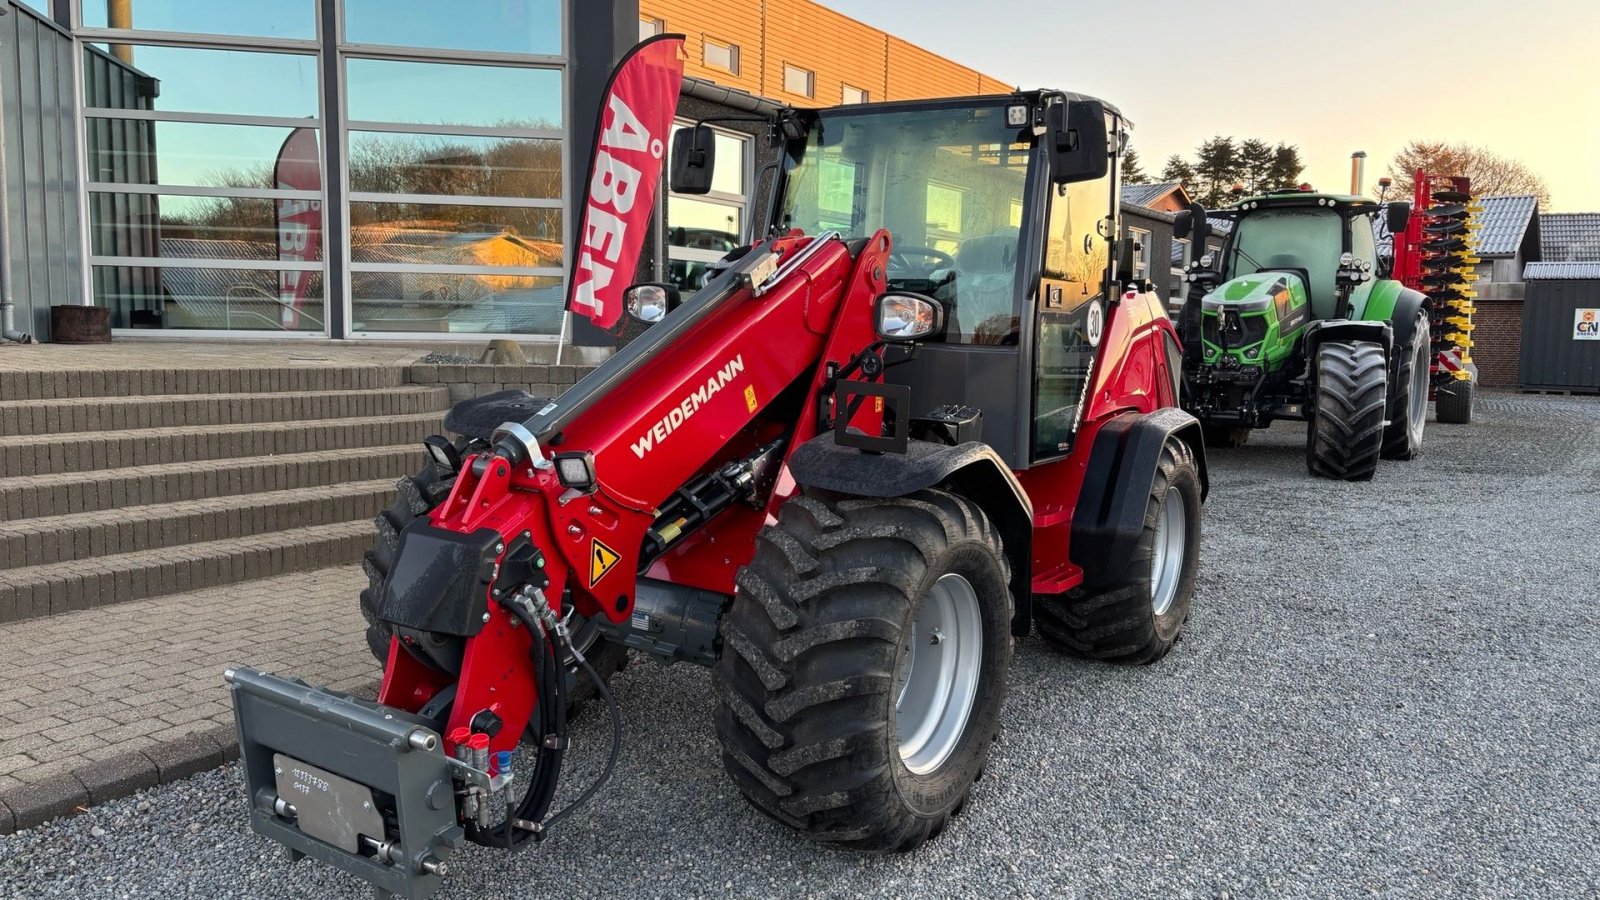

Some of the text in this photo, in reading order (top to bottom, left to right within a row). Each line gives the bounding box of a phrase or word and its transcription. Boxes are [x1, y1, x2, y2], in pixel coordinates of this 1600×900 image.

[575, 92, 664, 317] ÅBEN
[1090, 310, 1100, 338] 30
[630, 353, 745, 460] WEIDEMANN
[1072, 355, 1095, 433] WEIDEMANN
